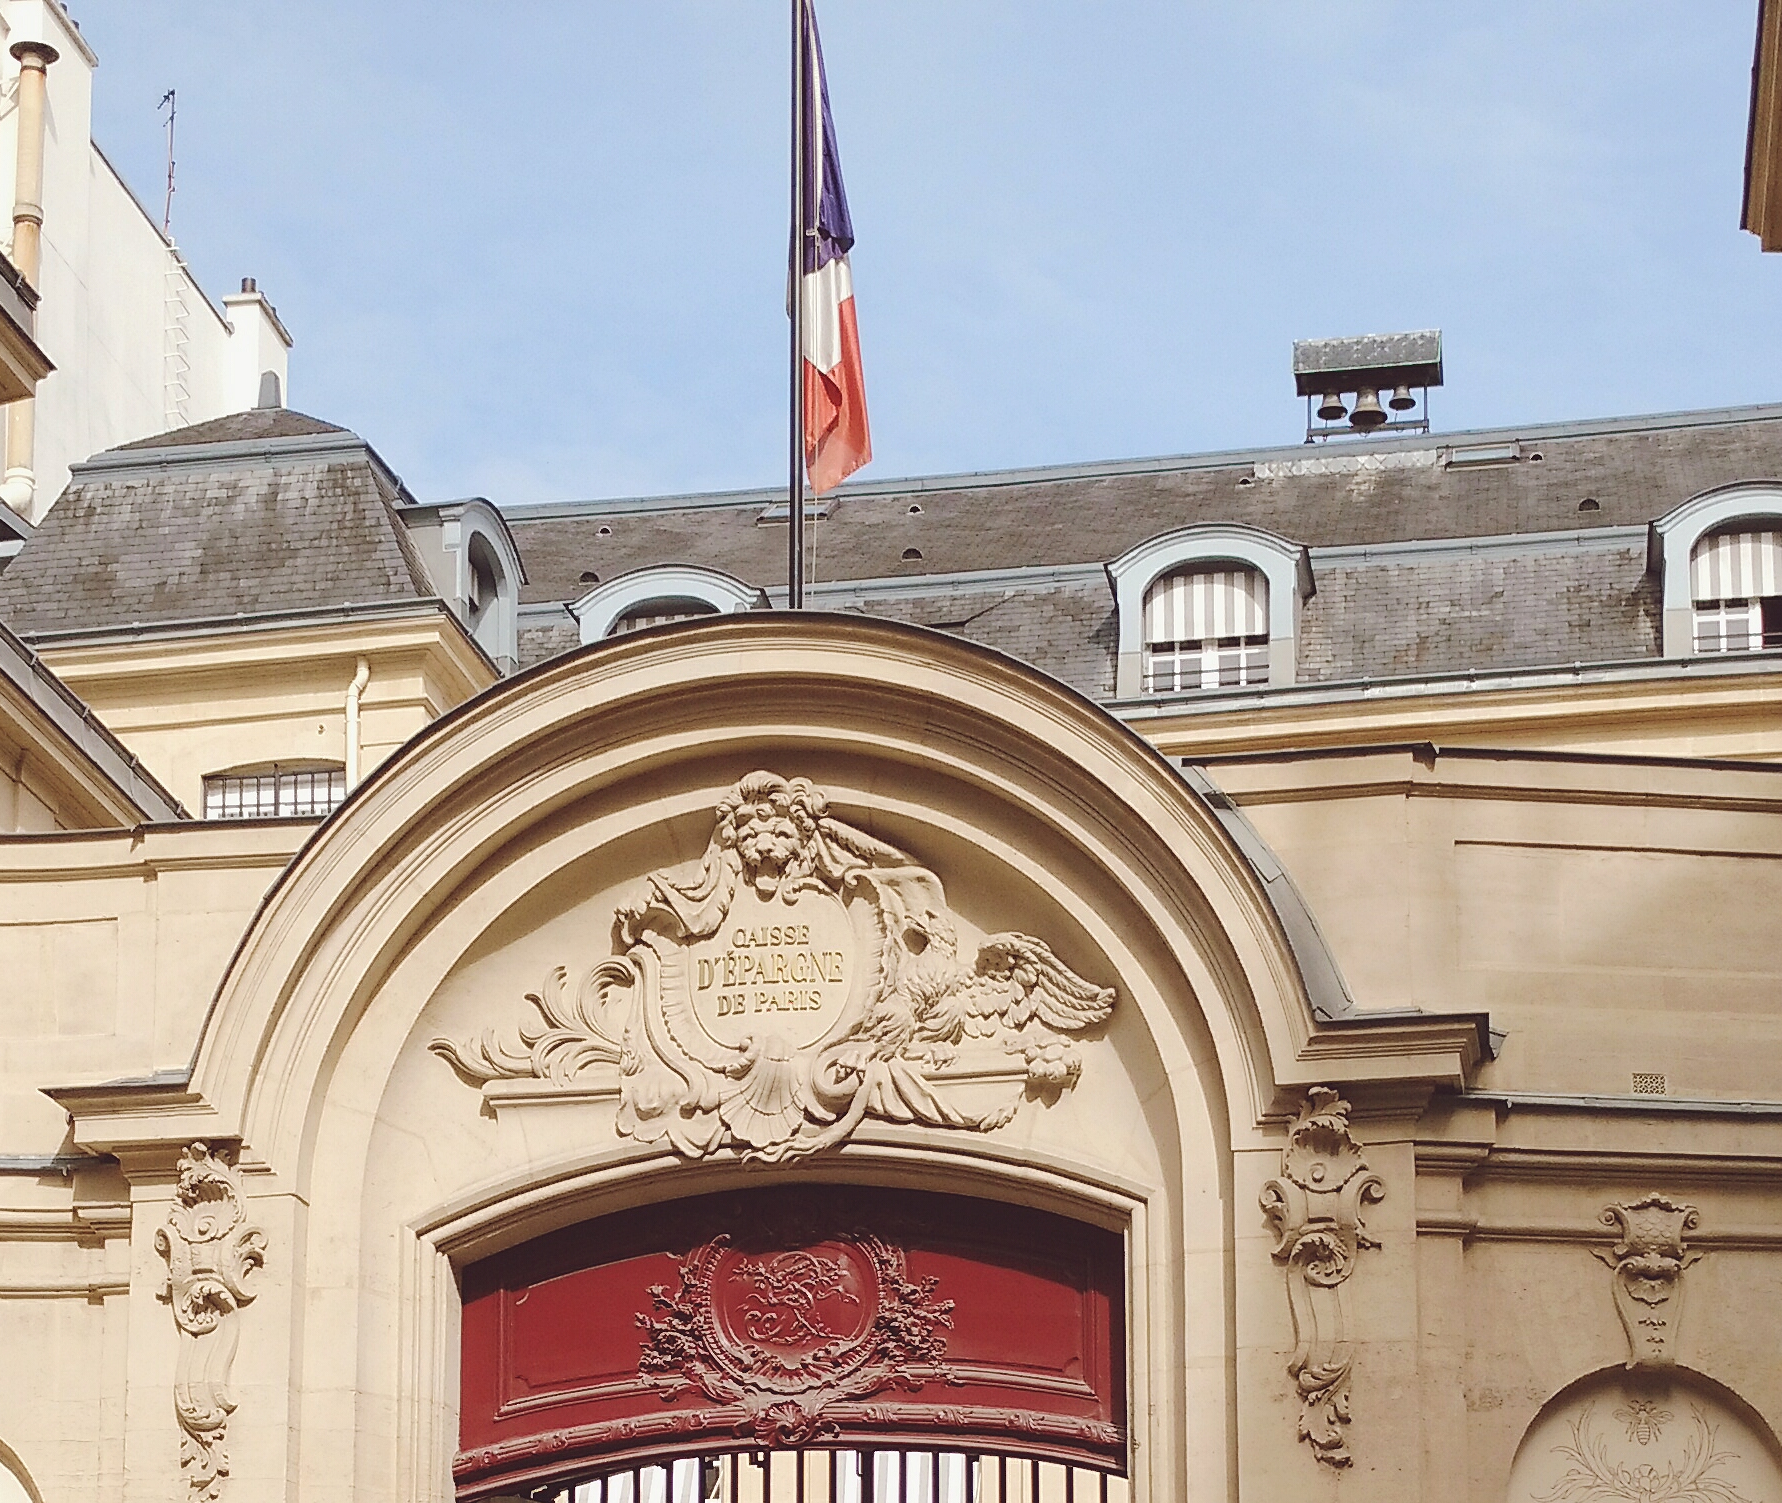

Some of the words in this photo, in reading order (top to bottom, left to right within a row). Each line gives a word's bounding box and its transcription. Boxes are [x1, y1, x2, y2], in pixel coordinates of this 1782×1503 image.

[732, 925, 810, 948] CAISSE
[697, 950, 844, 991] D'ÉPARGNE
[717, 994, 746, 1017] DE
[754, 991, 822, 1013] PARIS
